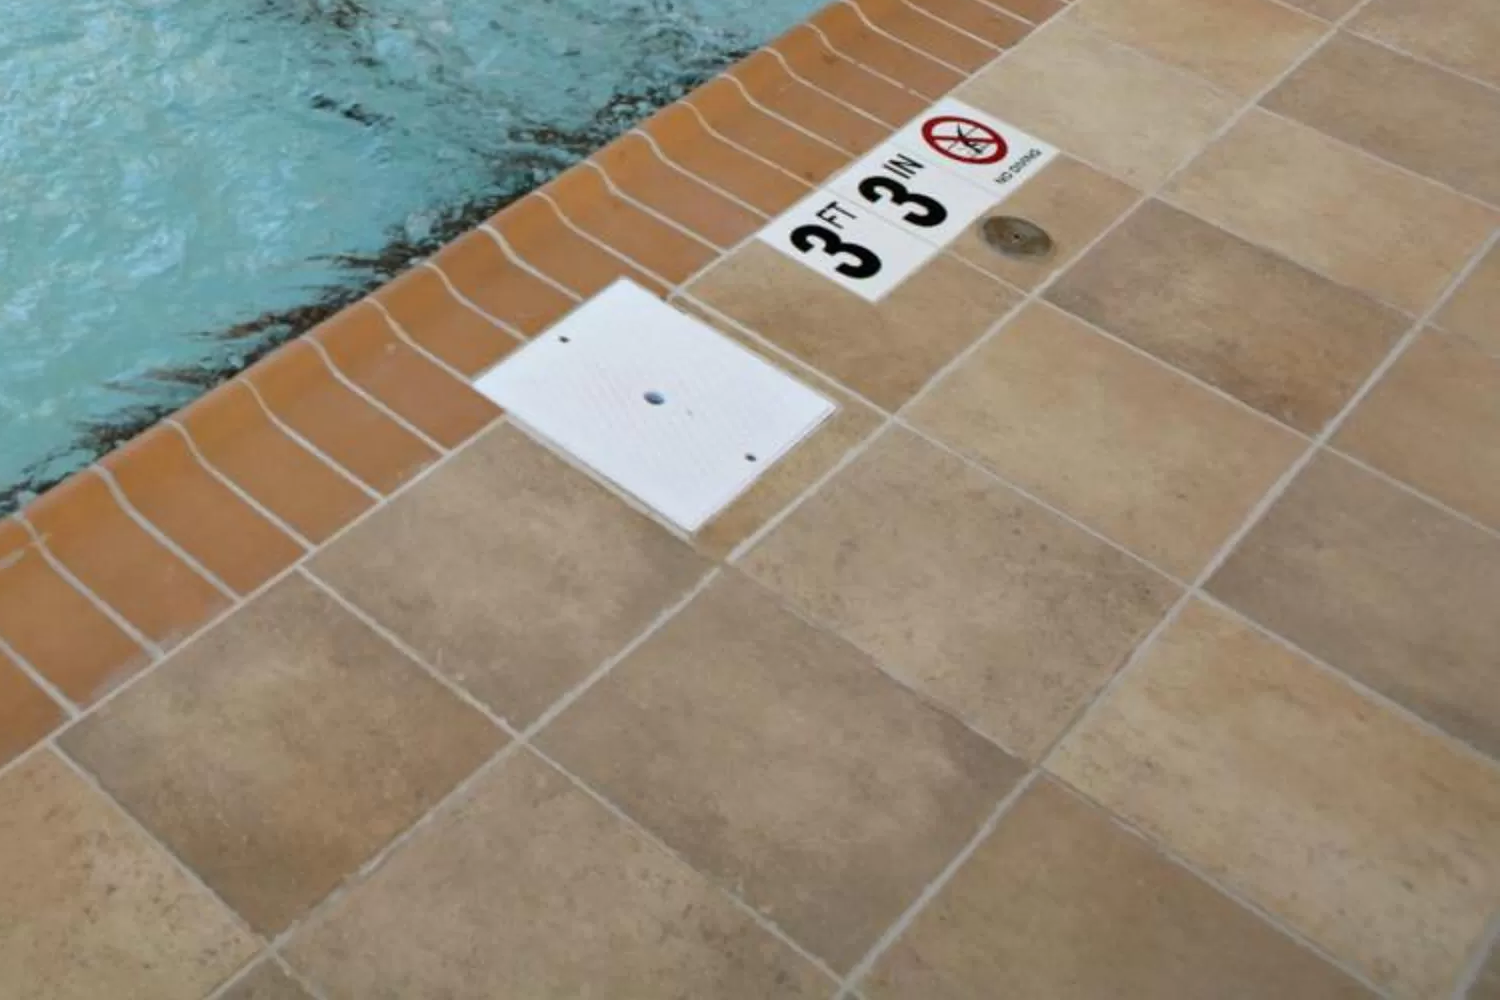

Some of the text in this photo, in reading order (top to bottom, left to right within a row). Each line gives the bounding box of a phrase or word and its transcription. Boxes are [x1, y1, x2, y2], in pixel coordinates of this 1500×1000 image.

[994, 147, 1042, 185] NO DIVING
[790, 153, 948, 279] 3 FT 3 IN
